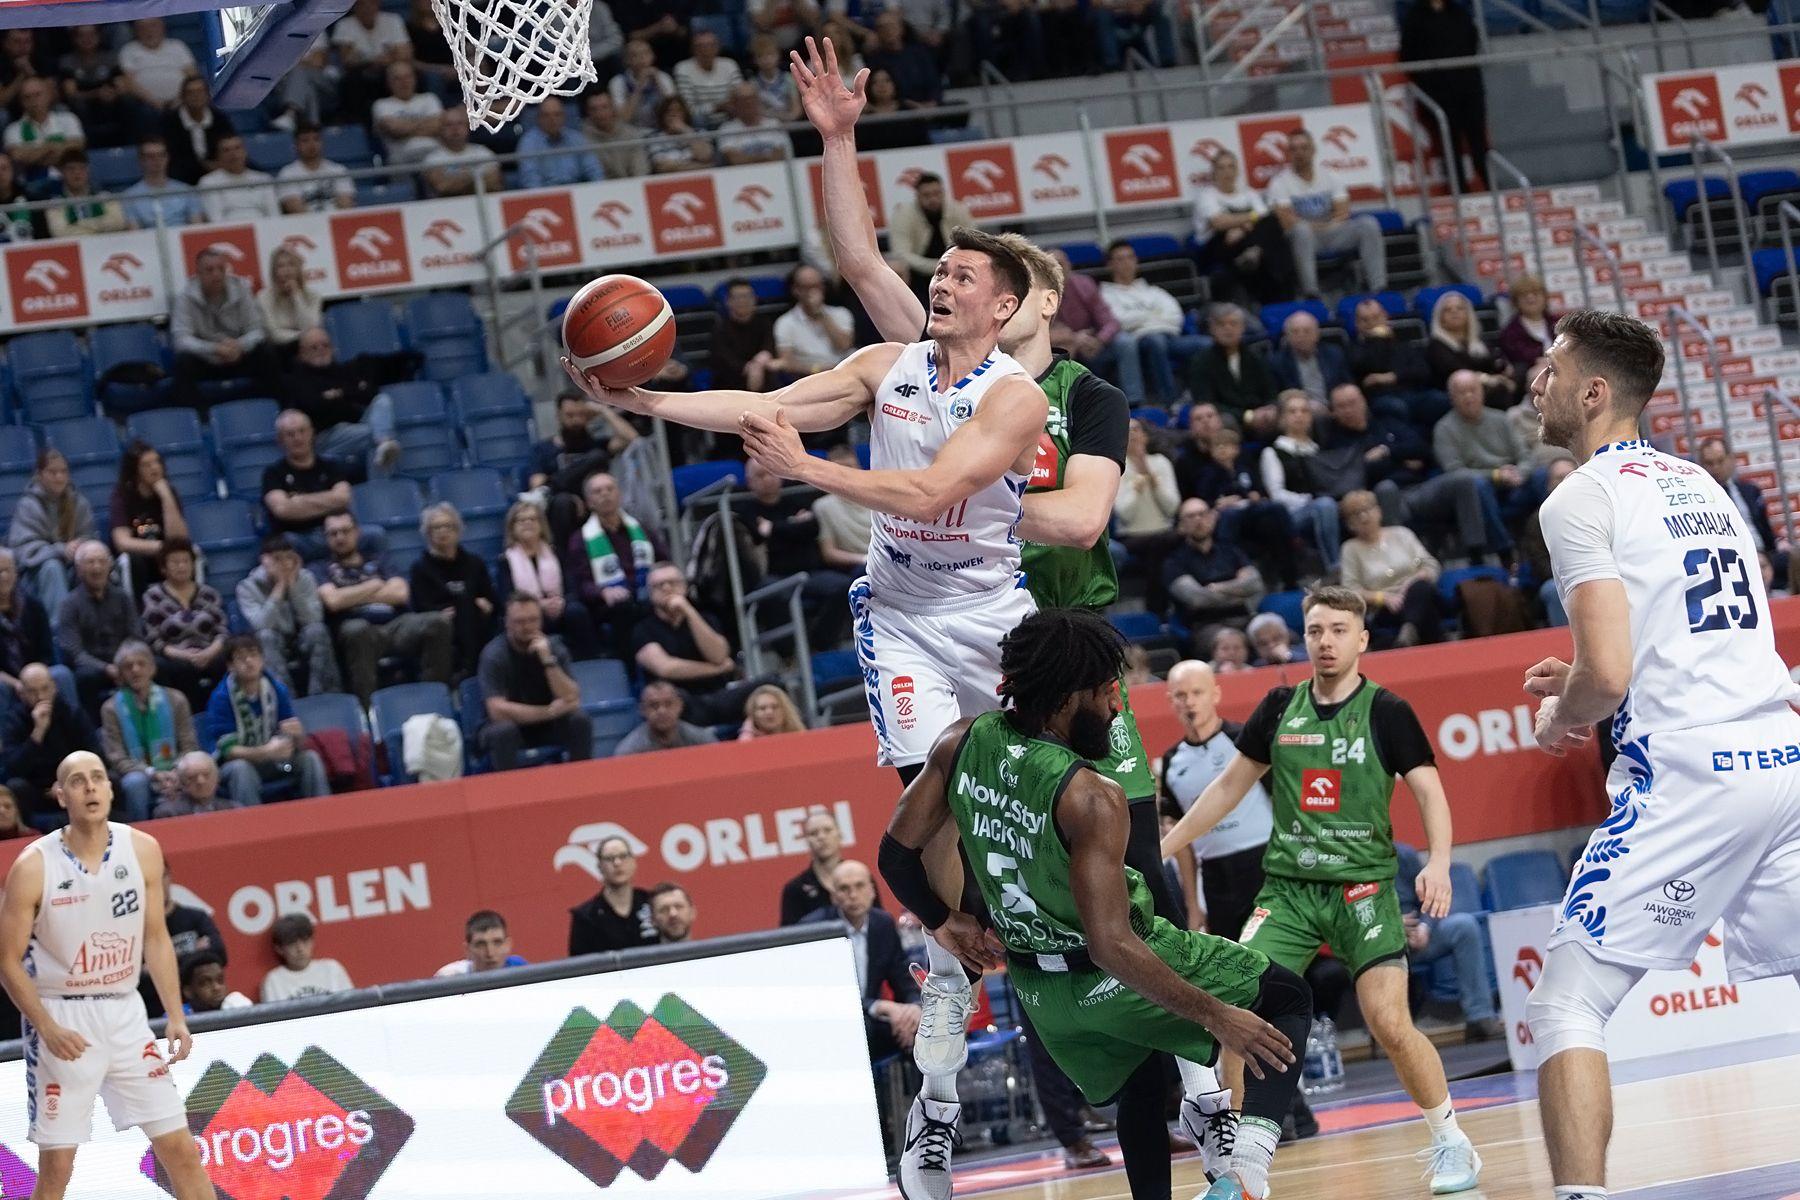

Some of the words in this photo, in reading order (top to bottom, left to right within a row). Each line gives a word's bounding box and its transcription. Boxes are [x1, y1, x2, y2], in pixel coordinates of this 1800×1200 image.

[1120, 175, 1171, 193] ORLEN
[661, 224, 714, 244] ORLEN
[732, 217, 783, 233] ORLEN
[346, 260, 400, 278] ORLEN
[20, 292, 79, 314] ORLEN
[99, 286, 153, 302] ORLEN
[894, 383, 919, 398] 4F
[883, 404, 907, 418] ORLEN
[1656, 476, 1687, 492] pre
[1666, 493, 1706, 506] zero
[1663, 511, 1738, 539] MICHALAK
[1683, 548, 1758, 633] 23
[897, 717, 917, 725] Basket
[1332, 737, 1366, 764] 24
[1115, 757, 1137, 773] 4F
[1306, 797, 1335, 806] ORLEN
[111, 888, 139, 918] 22
[228, 862, 432, 935] ORLEN
[1643, 902, 1696, 920] JAWORSKI
[68, 935, 135, 975] Anwil
[65, 979, 101, 987] GRUPA
[1650, 984, 1739, 1016] ORLEN
[542, 1052, 729, 1125] progres
